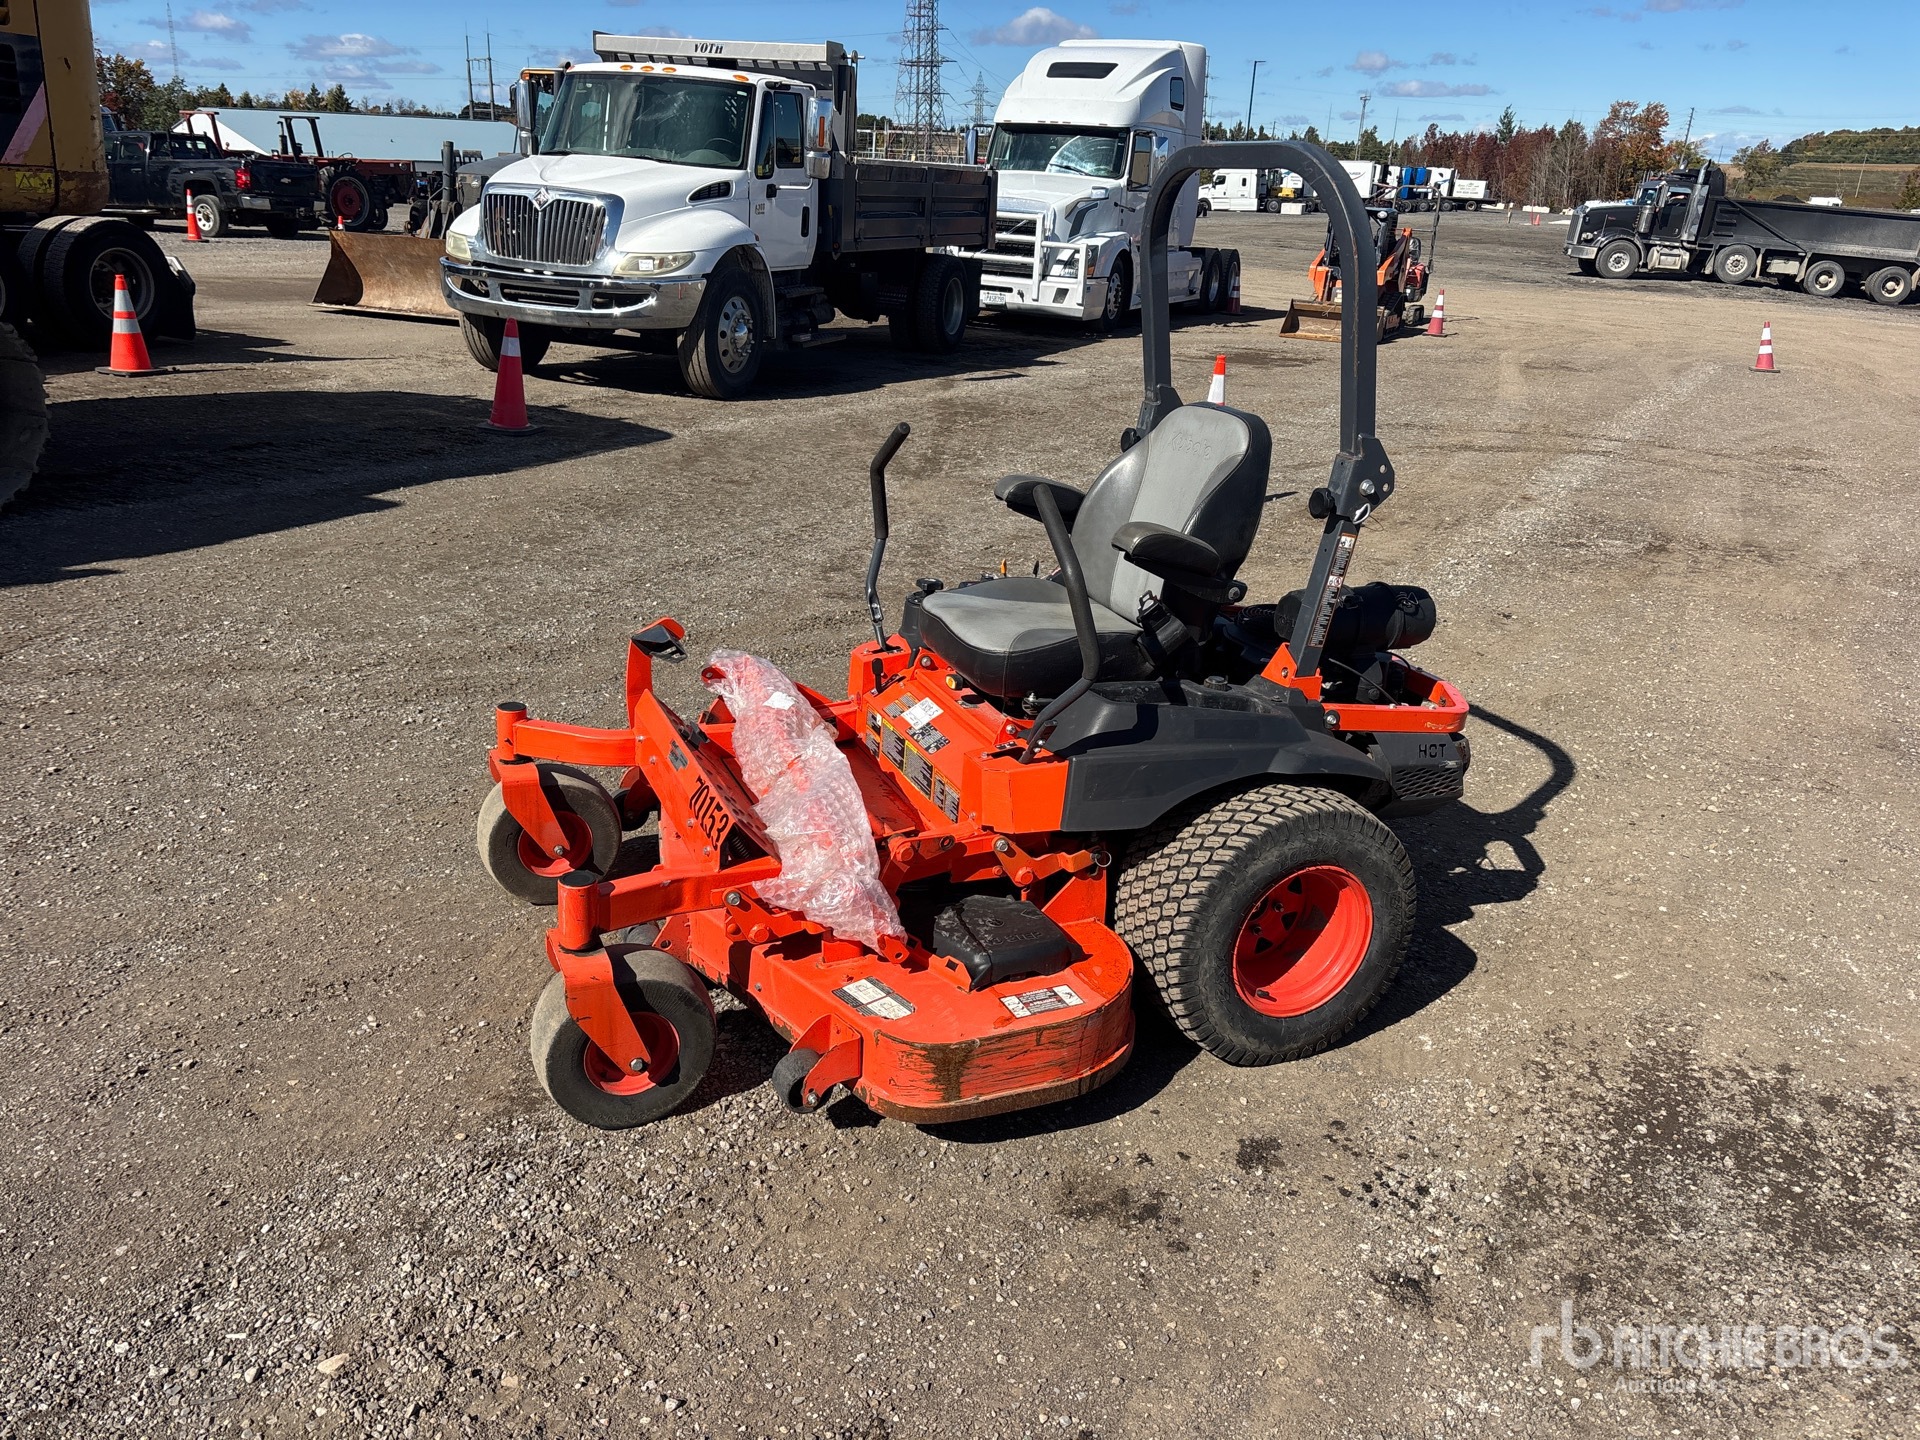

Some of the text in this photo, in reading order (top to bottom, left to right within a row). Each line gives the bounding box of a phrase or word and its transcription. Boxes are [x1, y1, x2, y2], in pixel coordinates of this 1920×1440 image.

[694, 42, 724, 54] VOTH
[1418, 743, 1447, 759] HOT
[689, 774, 729, 852] 70153
